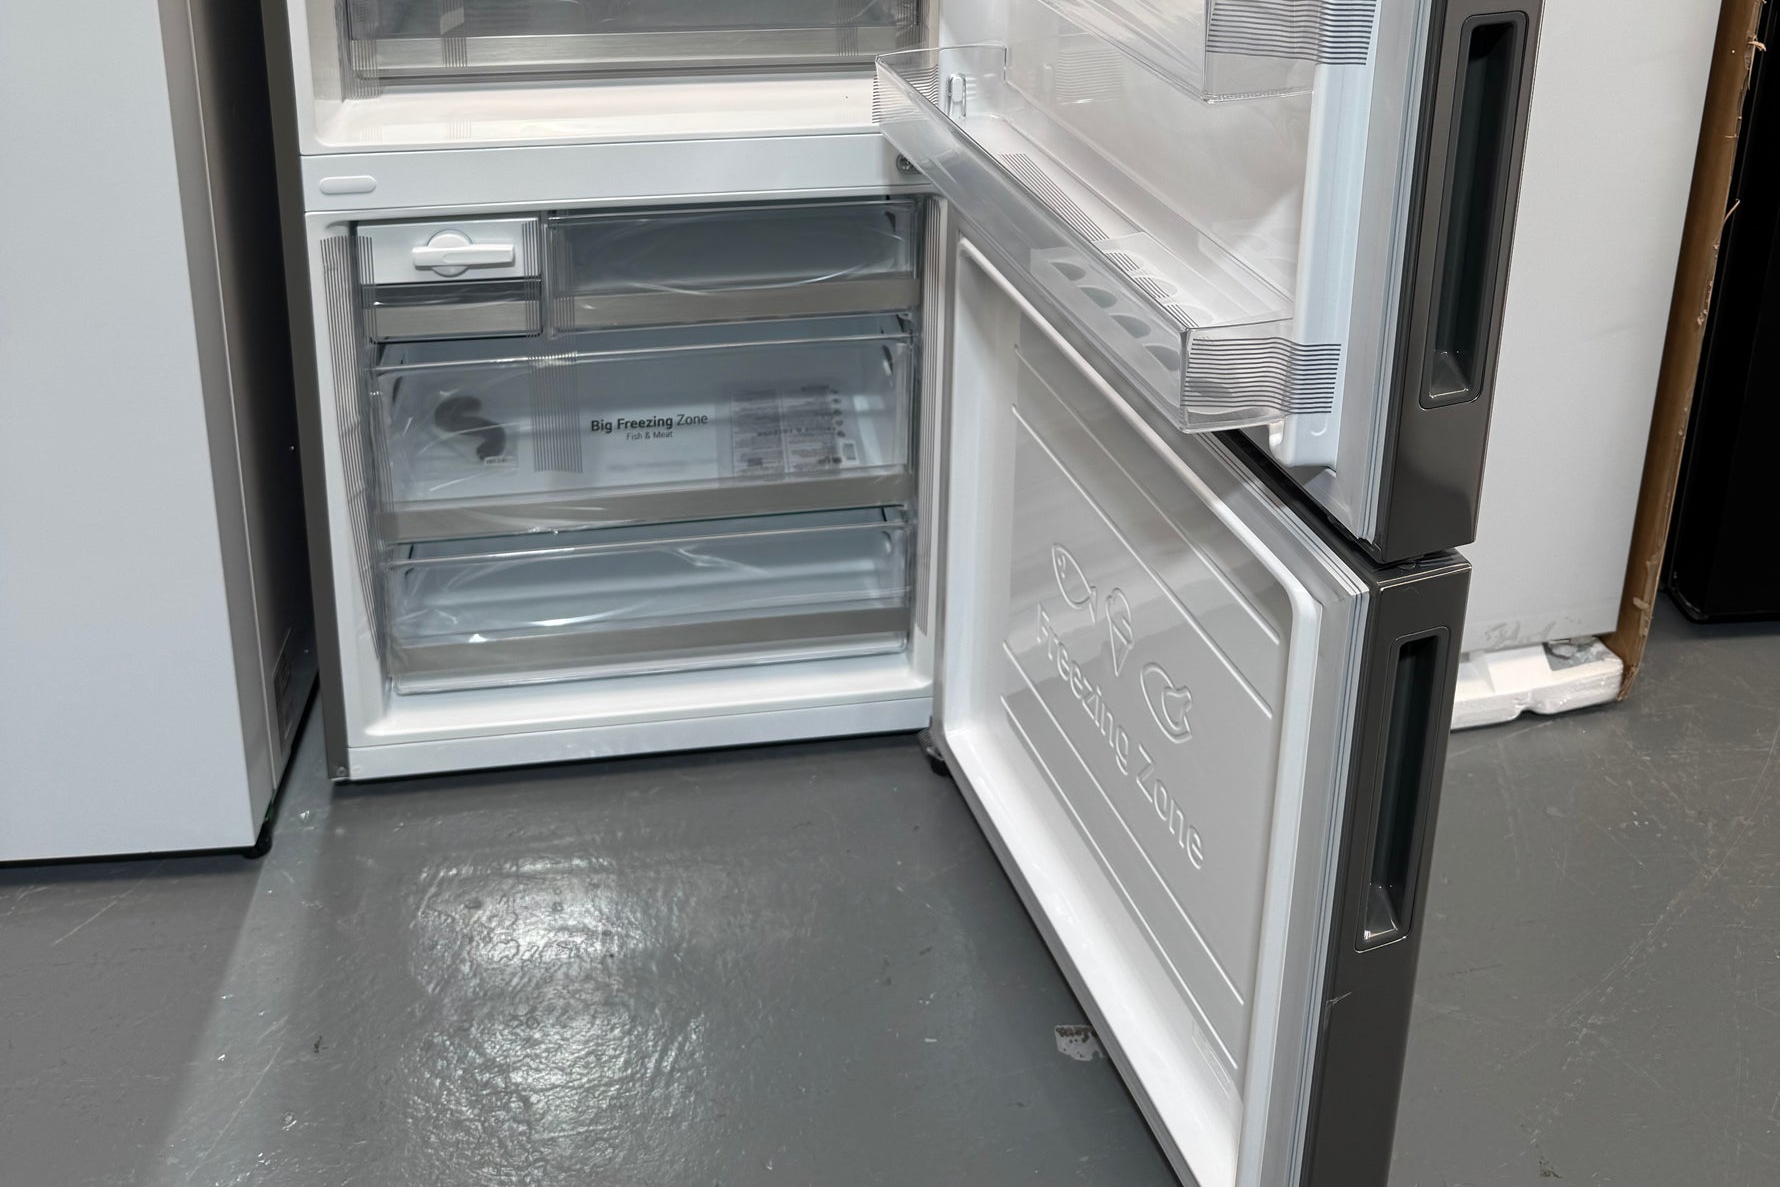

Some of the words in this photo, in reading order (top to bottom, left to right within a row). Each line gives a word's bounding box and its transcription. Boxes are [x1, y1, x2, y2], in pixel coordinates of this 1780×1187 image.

[591, 419, 613, 433] Big
[616, 415, 673, 430] Freezing
[676, 414, 708, 426] Zone
[626, 432, 643, 440] Fish
[645, 431, 651, 439] &
[653, 430, 673, 438] Meat
[1036, 601, 1130, 776] Freezing
[1135, 742, 1204, 870] Zone
